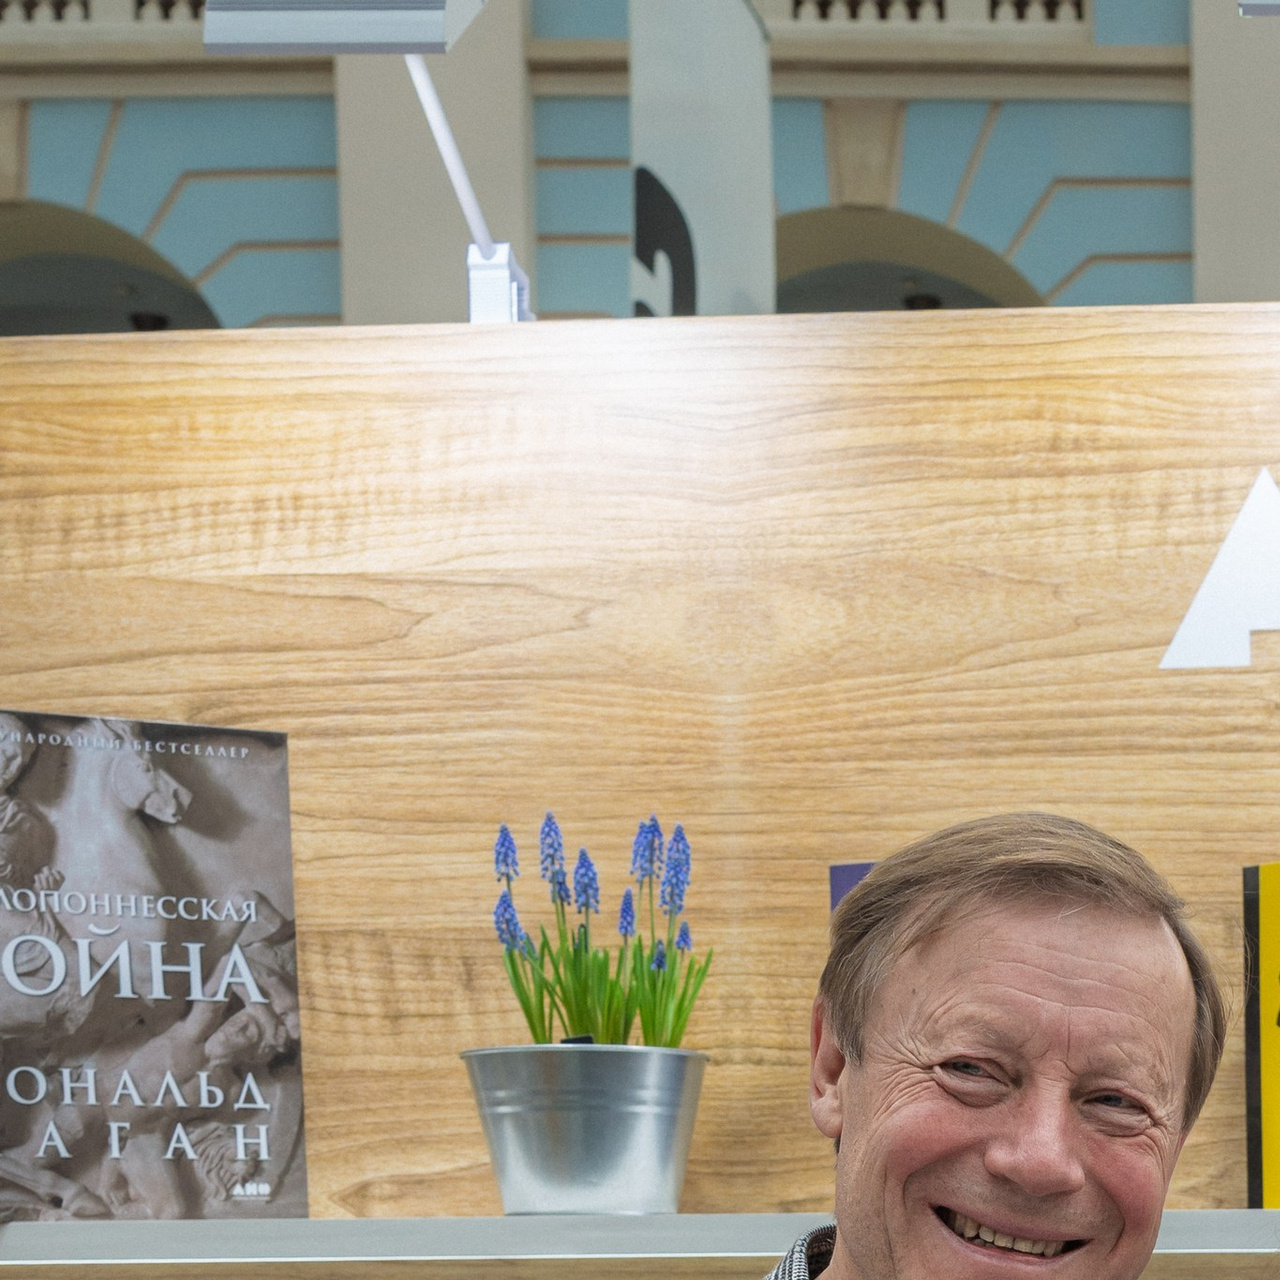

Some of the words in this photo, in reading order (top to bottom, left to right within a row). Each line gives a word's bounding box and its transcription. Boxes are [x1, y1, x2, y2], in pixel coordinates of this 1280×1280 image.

[133, 740, 249, 759] БЕСТСЕЛЛЕР
[2, 923, 269, 1005] ОЙНА
[6, 1065, 271, 1111] ОНАЛЬД
[35, 1121, 272, 1162] АГАН
